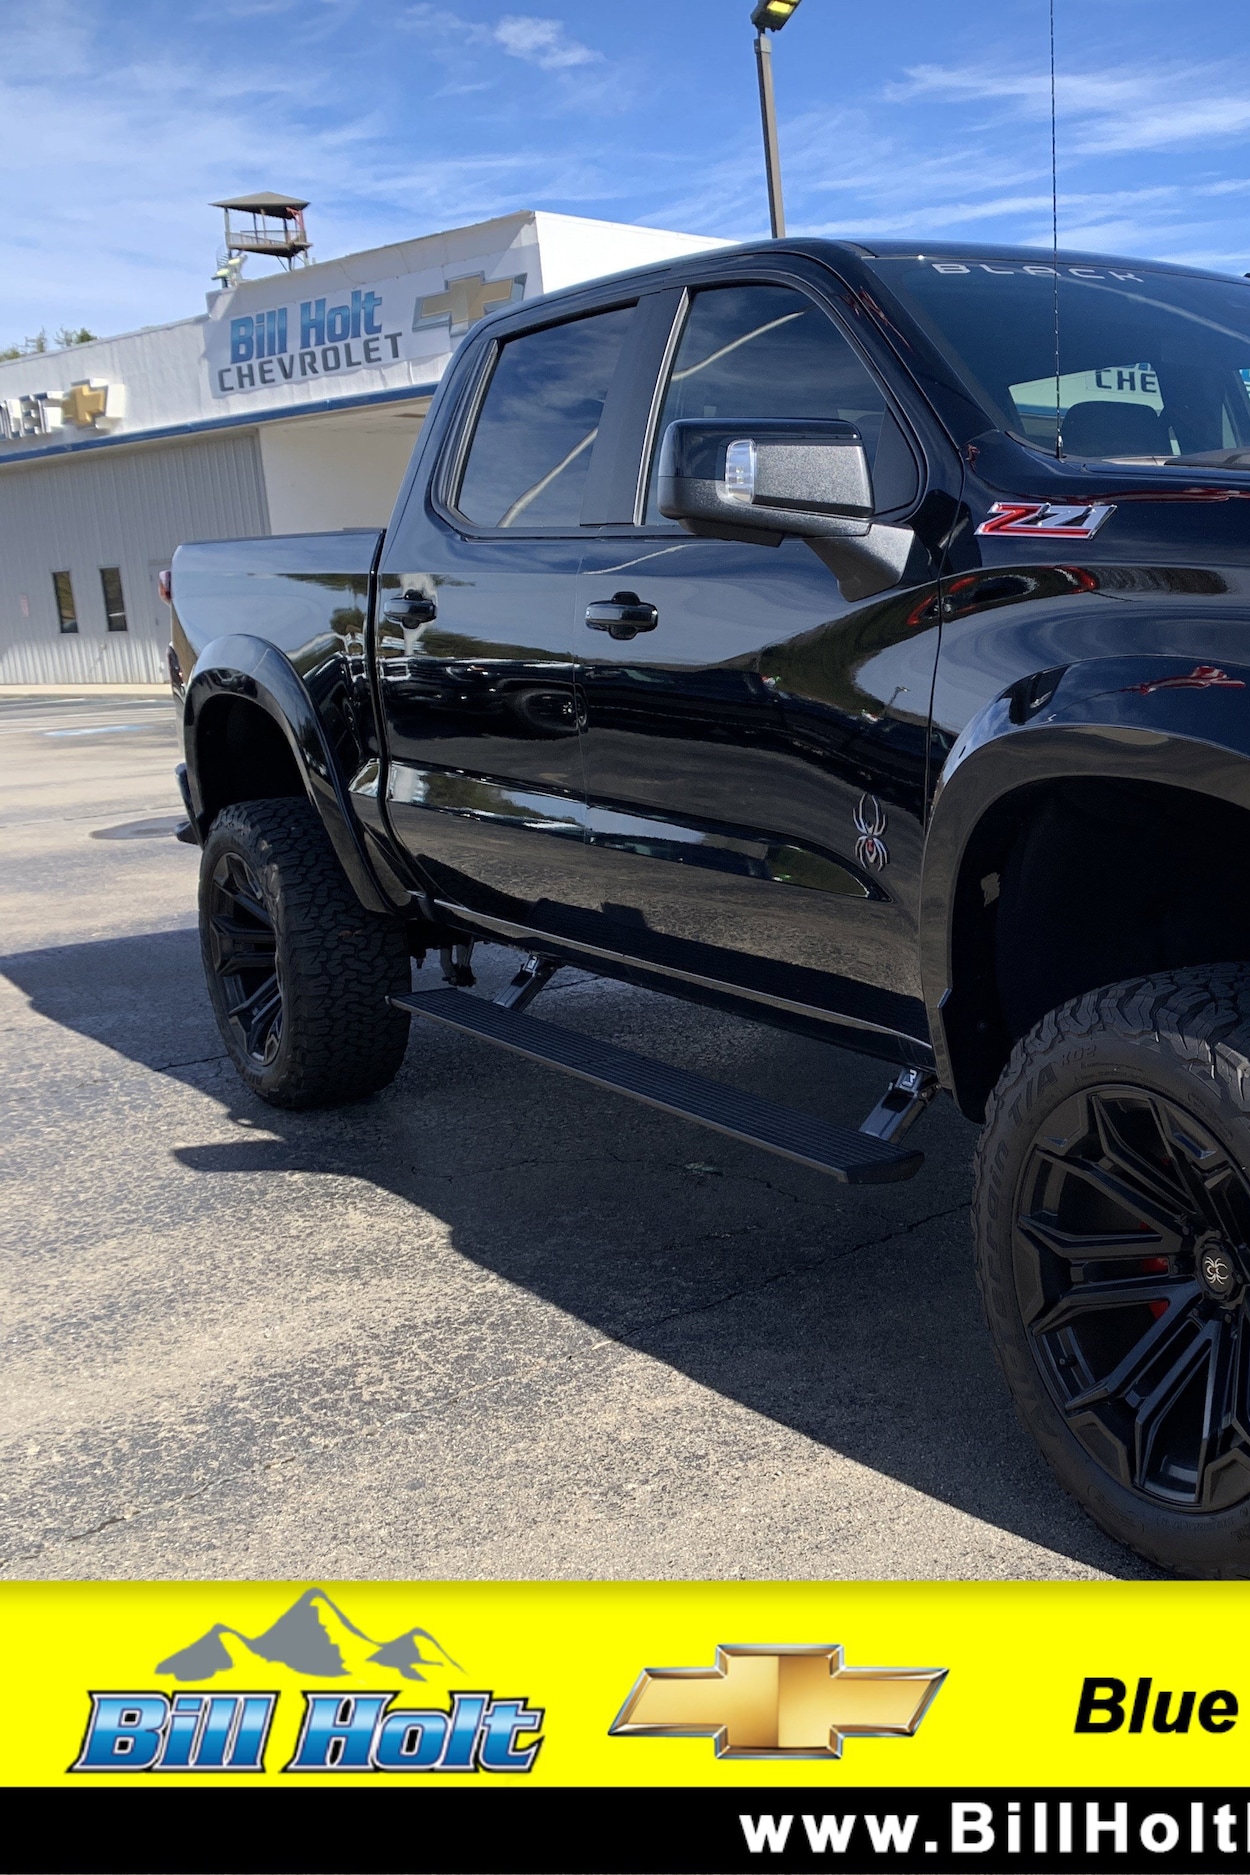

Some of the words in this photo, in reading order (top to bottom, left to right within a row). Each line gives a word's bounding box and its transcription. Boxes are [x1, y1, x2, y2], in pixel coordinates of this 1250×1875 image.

[931, 262, 1145, 283] BLACK
[230, 307, 287, 364] Bill
[300, 290, 382, 349] Holt
[218, 332, 402, 391] CHEVROLET
[0, 390, 62, 440] LET
[974, 502, 1117, 540] Z71
